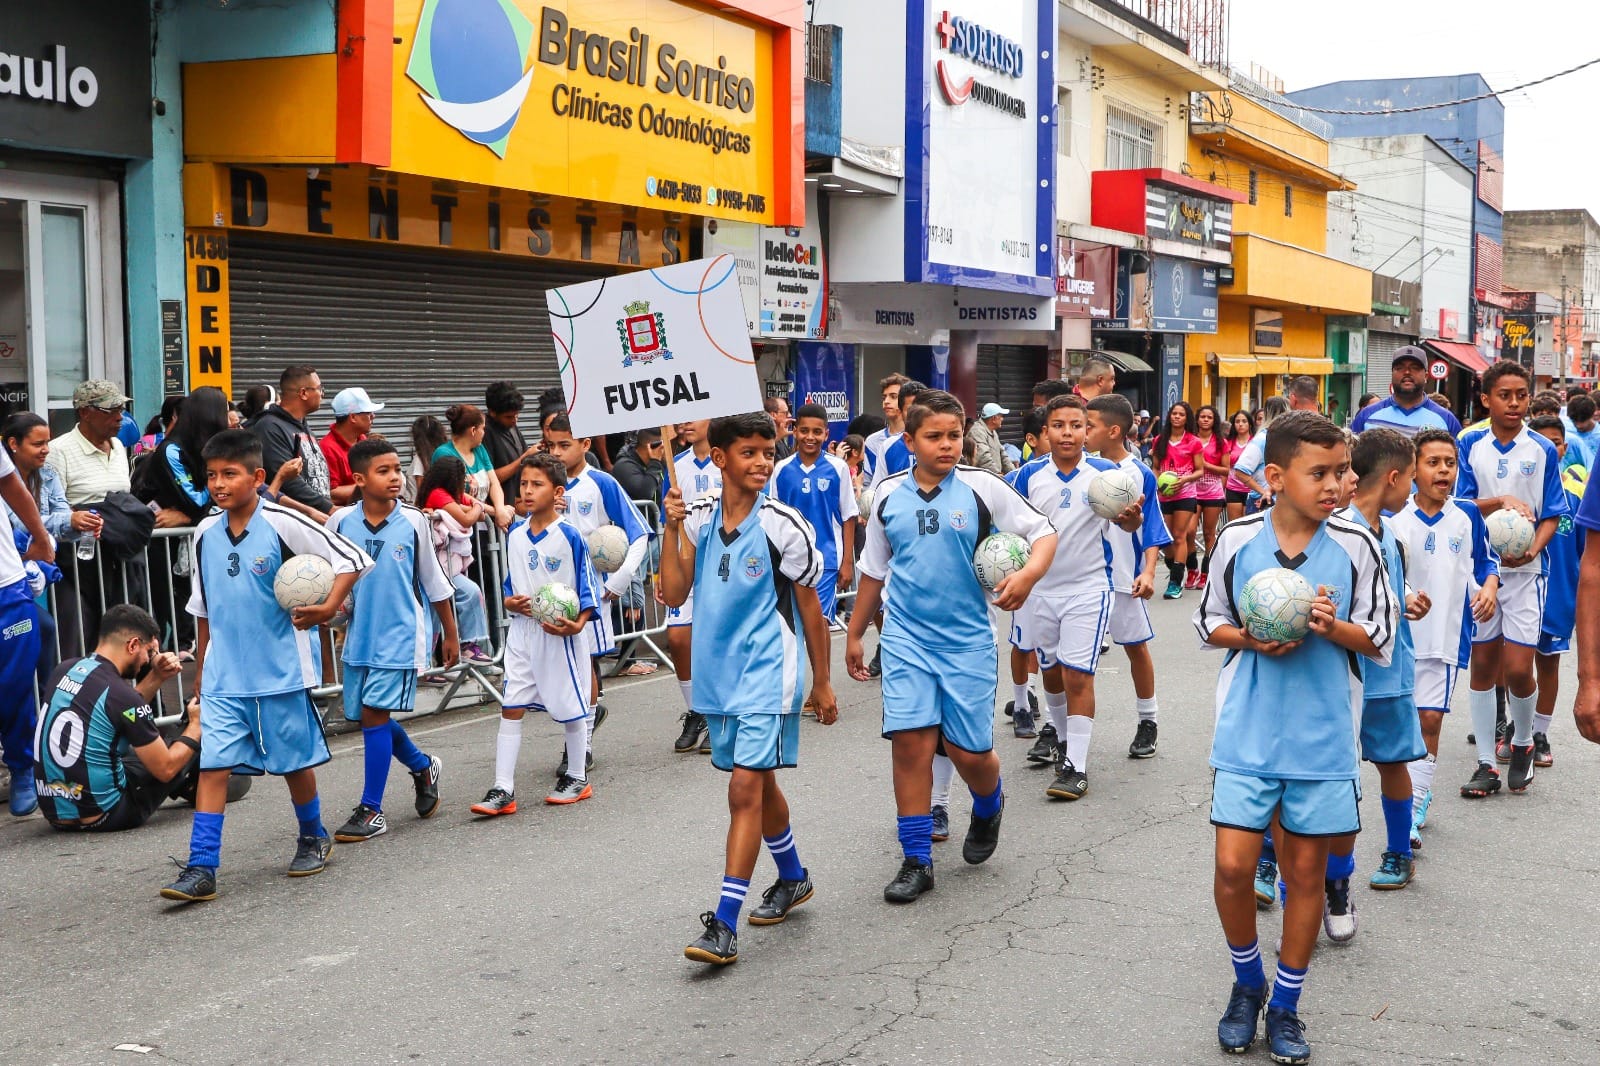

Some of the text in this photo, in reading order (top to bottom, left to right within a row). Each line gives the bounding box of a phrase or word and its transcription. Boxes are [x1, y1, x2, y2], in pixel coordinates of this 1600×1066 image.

[951, 16, 1023, 78] SORRISO
[538, 6, 755, 114] Brasil Sorriso
[0, 45, 98, 107] aulo
[639, 102, 751, 154] Odontológicas
[230, 169, 681, 267] DENTISTAS
[875, 310, 915, 326] DENTISTAS
[958, 307, 1037, 320] DENTISTAS
[196, 265, 223, 393] DEN
[1503, 320, 1530, 336] Tom
[1433, 365, 1445, 374] 30
[603, 371, 710, 415] FUTSAL
[812, 391, 847, 408] SORRISO
[1496, 458, 1509, 479] 5
[801, 477, 811, 494] 3
[1060, 489, 1071, 509] 2
[915, 509, 940, 536] 13
[364, 539, 385, 561] 17
[1424, 531, 1436, 555] 4
[227, 552, 241, 578] 3
[528, 549, 539, 571] 3
[717, 553, 731, 582] 4
[33, 701, 85, 769] 10
